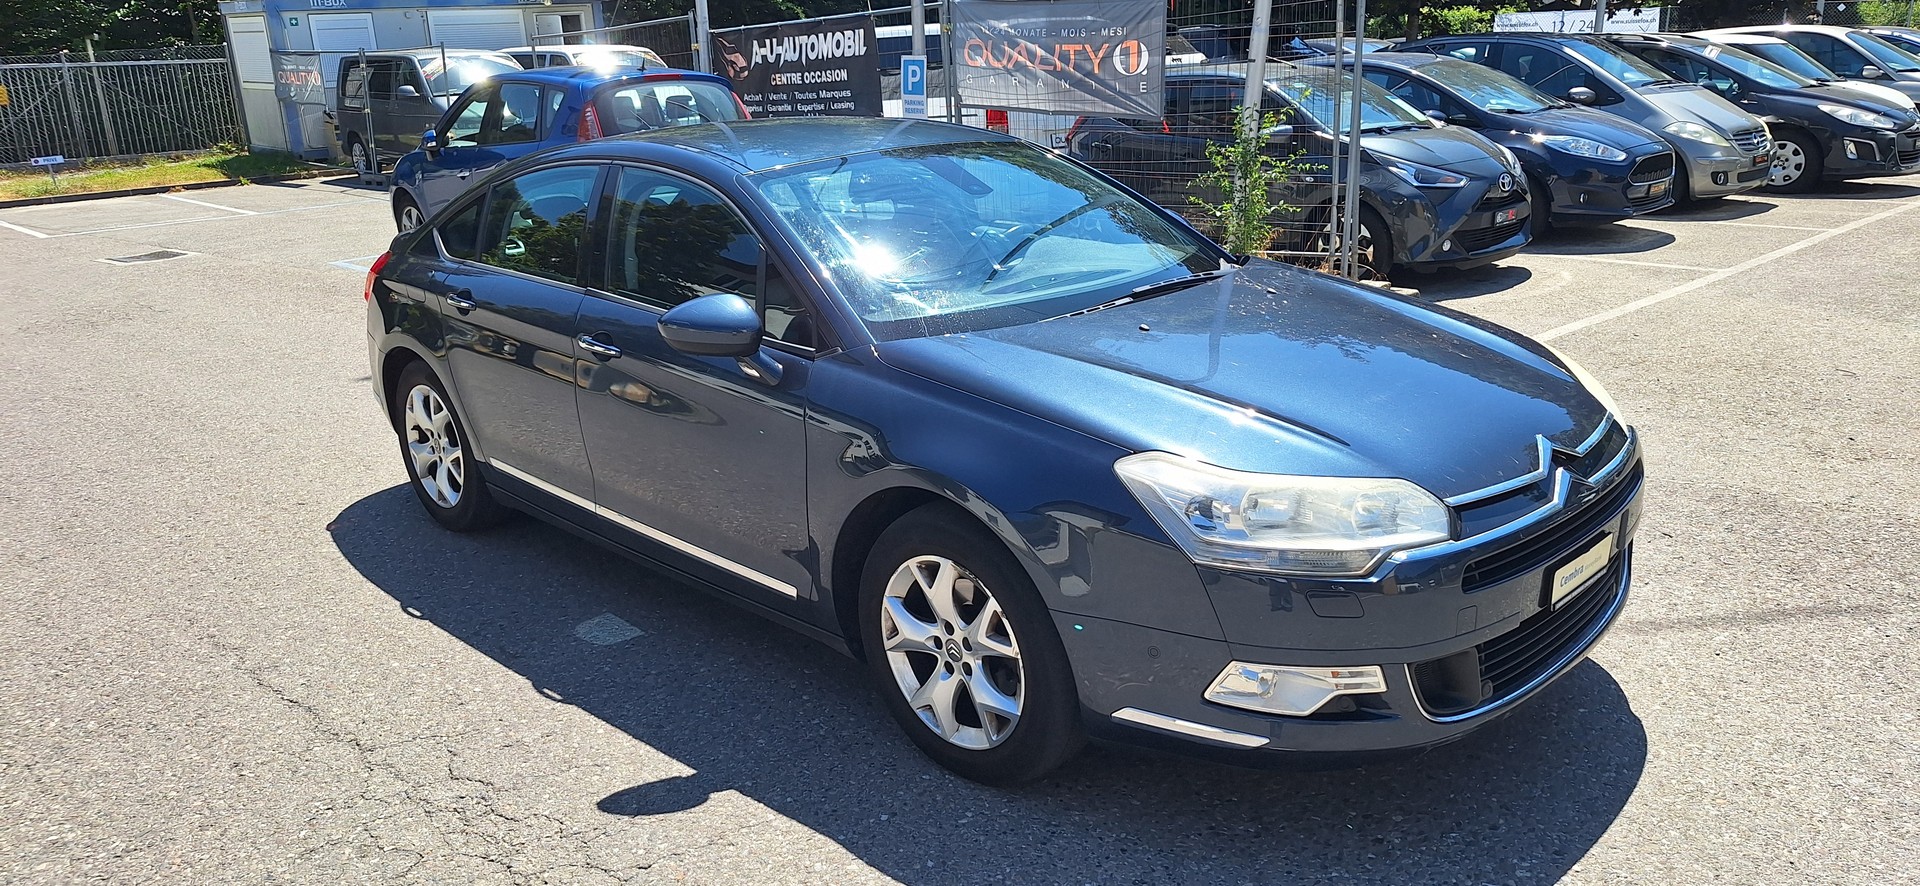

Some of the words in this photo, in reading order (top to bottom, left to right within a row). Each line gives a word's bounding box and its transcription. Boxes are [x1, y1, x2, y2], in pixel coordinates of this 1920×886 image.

[1009, 28, 1047, 38] MONATE
[1061, 28, 1087, 38] MOIS
[1101, 26, 1127, 37] MESI
[1578, 19, 1594, 32] 24
[750, 28, 867, 70] A-U-AUTOMOBIL
[964, 38, 1109, 74] QUALITY
[770, 72, 802, 86] CENTRE
[803, 68, 848, 84] OCCASION
[908, 65, 921, 91] P
[743, 93, 763, 101] Achat
[768, 92, 788, 100] Vente
[794, 91, 818, 100] Toutes
[819, 89, 852, 99] Marques
[767, 104, 792, 112] Garantie
[797, 102, 825, 112] Expertise
[830, 101, 855, 111] Leasing
[904, 99, 925, 107] PARKING
[1560, 565, 1584, 587] Cembra
